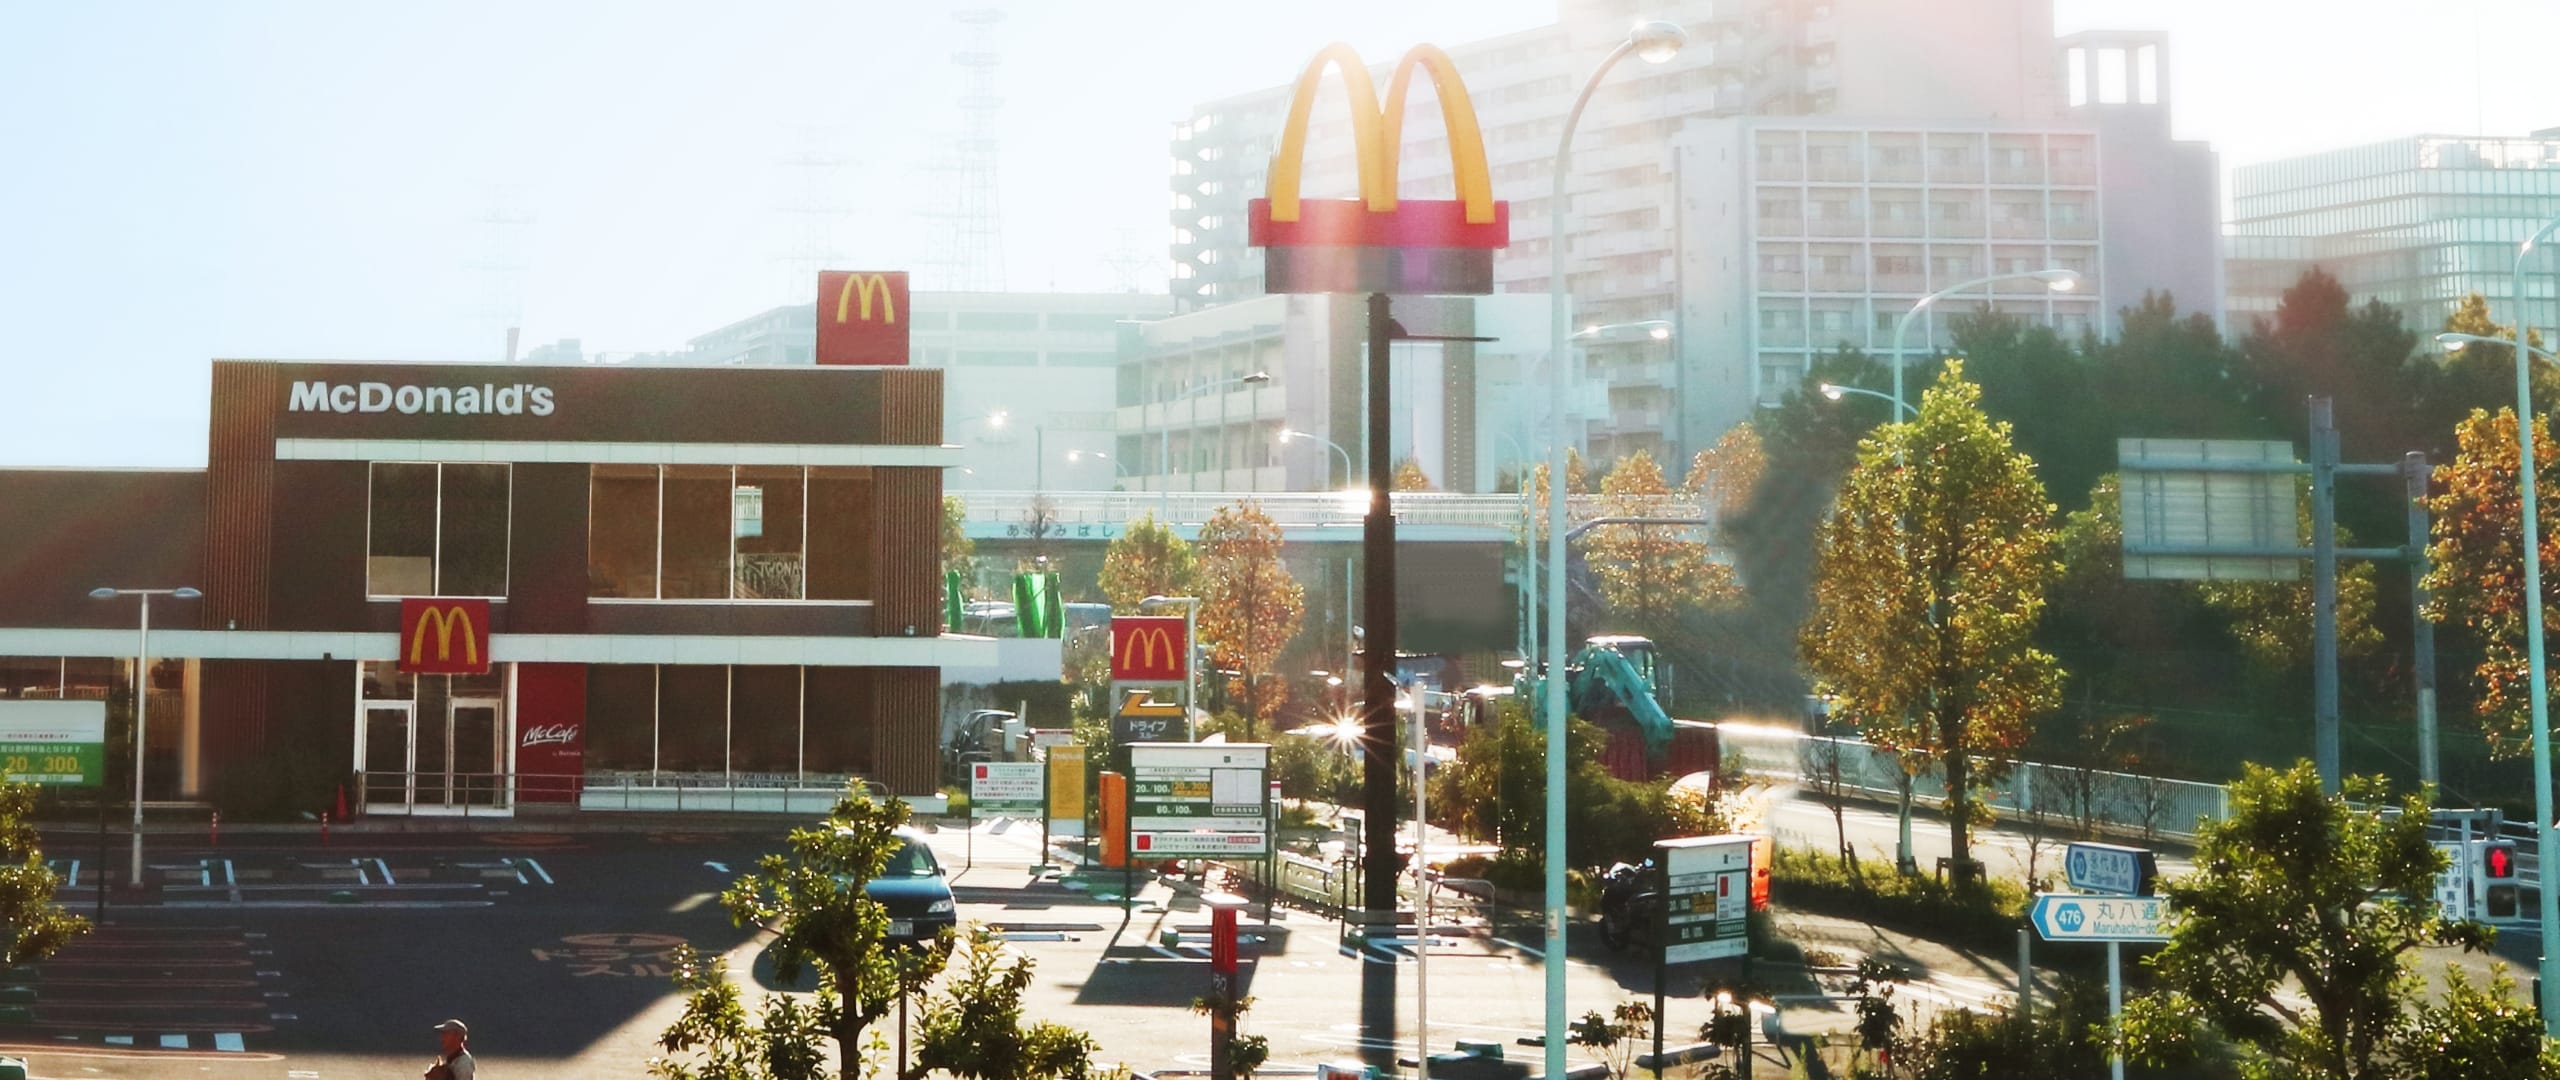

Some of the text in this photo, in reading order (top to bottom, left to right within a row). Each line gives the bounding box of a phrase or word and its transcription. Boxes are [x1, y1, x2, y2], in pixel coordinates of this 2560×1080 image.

[289, 381, 555, 416] McDonald's
[1129, 721, 1167, 732] ドライブ
[2058, 909, 2081, 926] 476
[2093, 921, 2158, 935] Maruhachi-do
